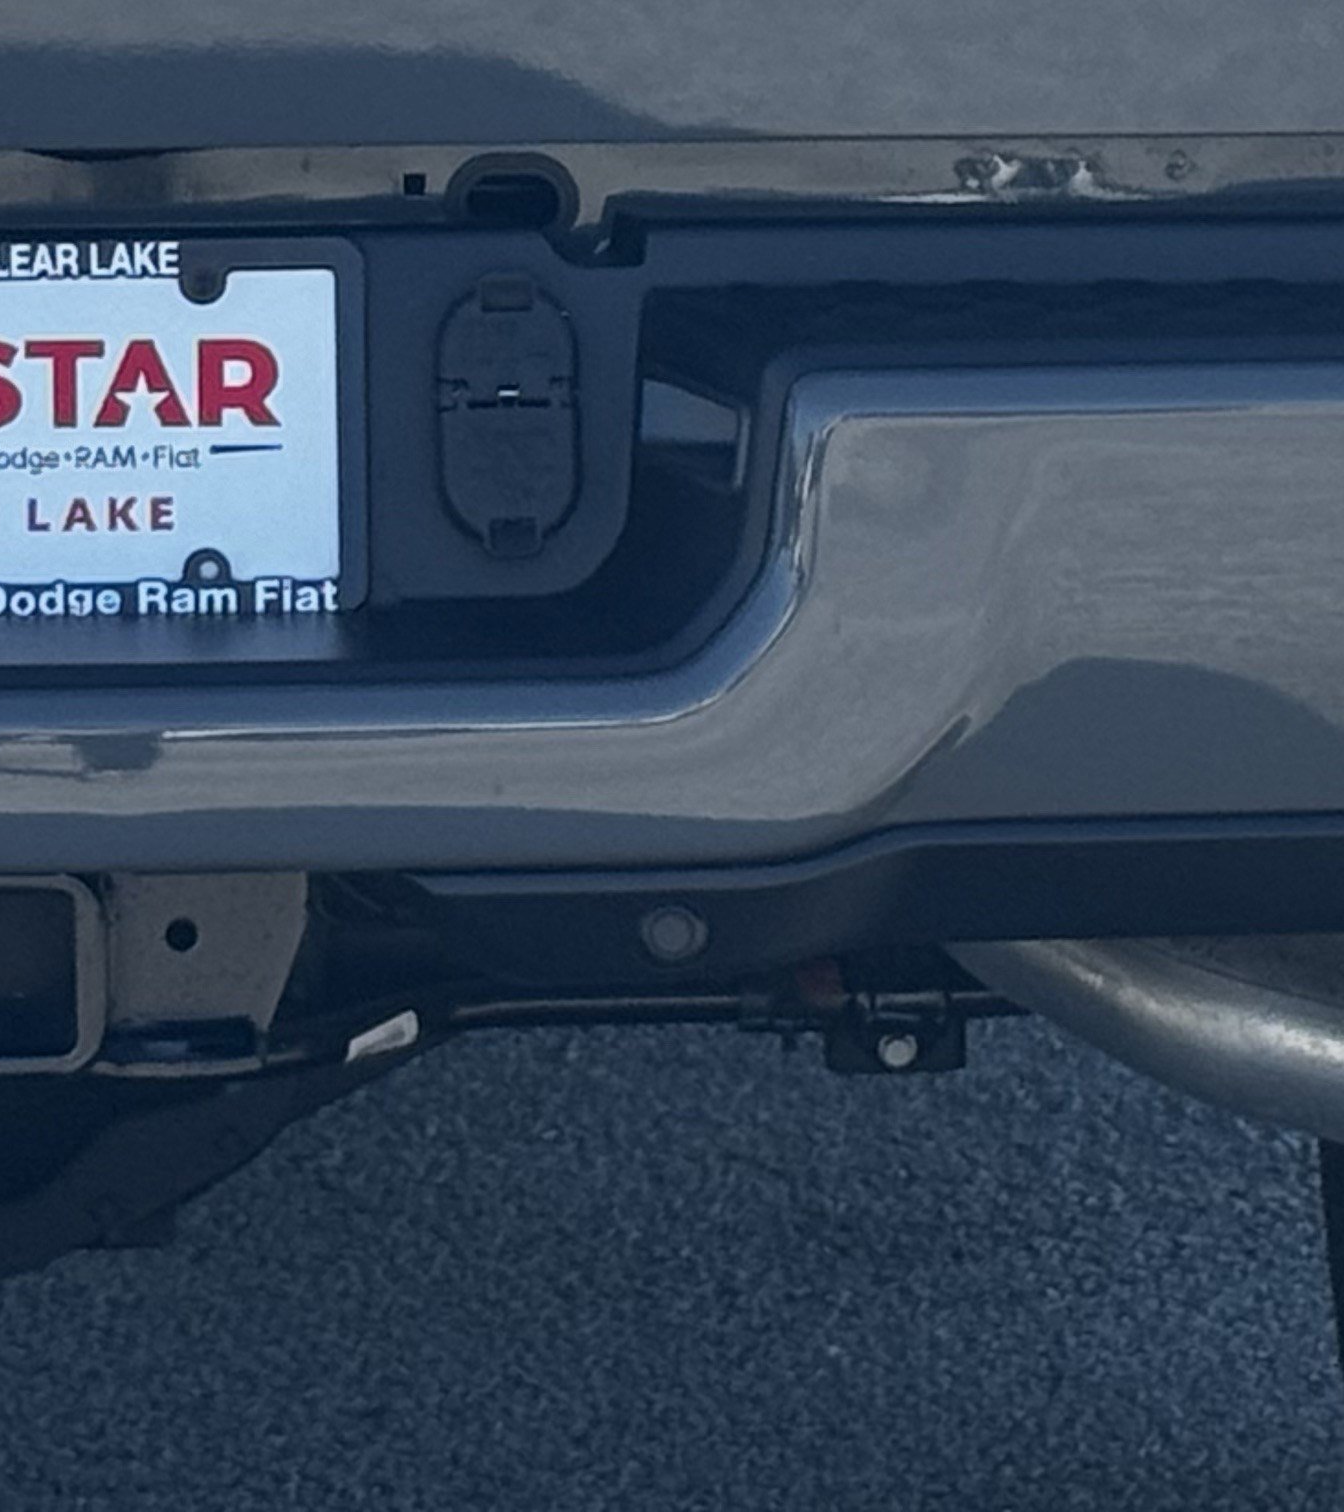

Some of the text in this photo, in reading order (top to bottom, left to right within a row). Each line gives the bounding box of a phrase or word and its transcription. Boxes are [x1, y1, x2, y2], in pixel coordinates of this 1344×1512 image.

[89, 241, 180, 275] LAKE
[74, 445, 137, 468] RAM
[152, 444, 202, 468] Fiat
[27, 496, 175, 533] LAKE
[137, 581, 238, 615] Ram
[254, 579, 338, 613] Fiat
